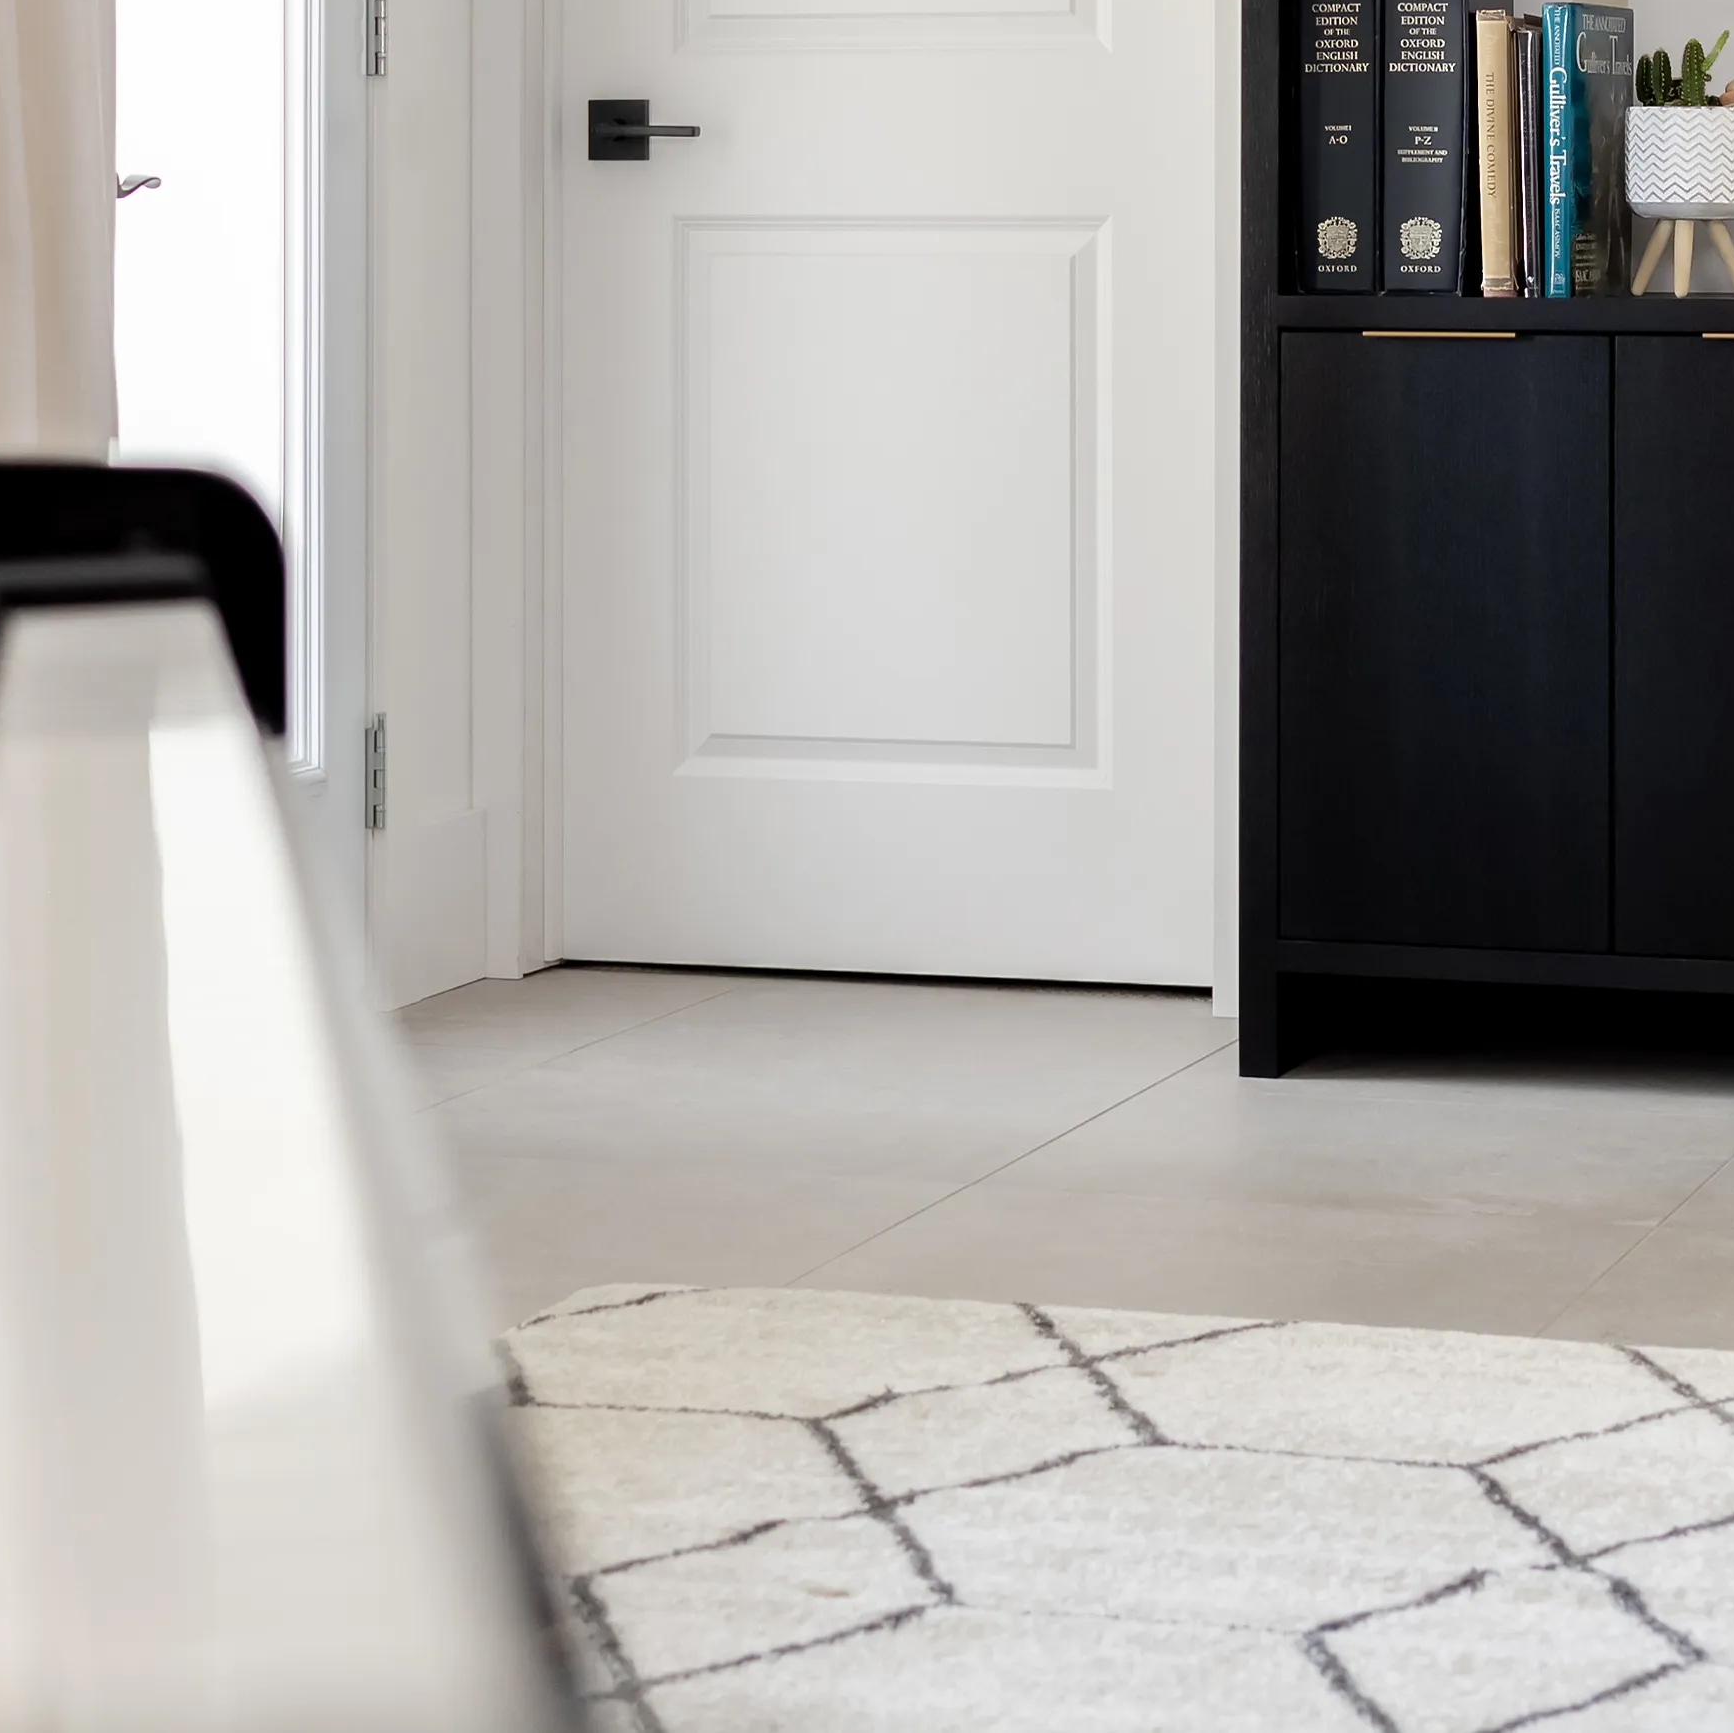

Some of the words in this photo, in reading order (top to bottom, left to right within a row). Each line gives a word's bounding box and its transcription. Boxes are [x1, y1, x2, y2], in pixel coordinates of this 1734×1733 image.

[1397, 3, 1449, 12] COMPACT
[1401, 16, 1445, 25] EDITION
[1400, 39, 1445, 48] OXFORD
[1401, 51, 1445, 60] ENGLISH
[1389, 63, 1456, 73] DICTIONARY
[1485, 73, 1495, 95] THE
[1548, 66, 1567, 146] Gulliver's
[1485, 98, 1496, 141] DIVINE
[1486, 145, 1497, 198] COMEDY
[1548, 153, 1566, 206] Travels
